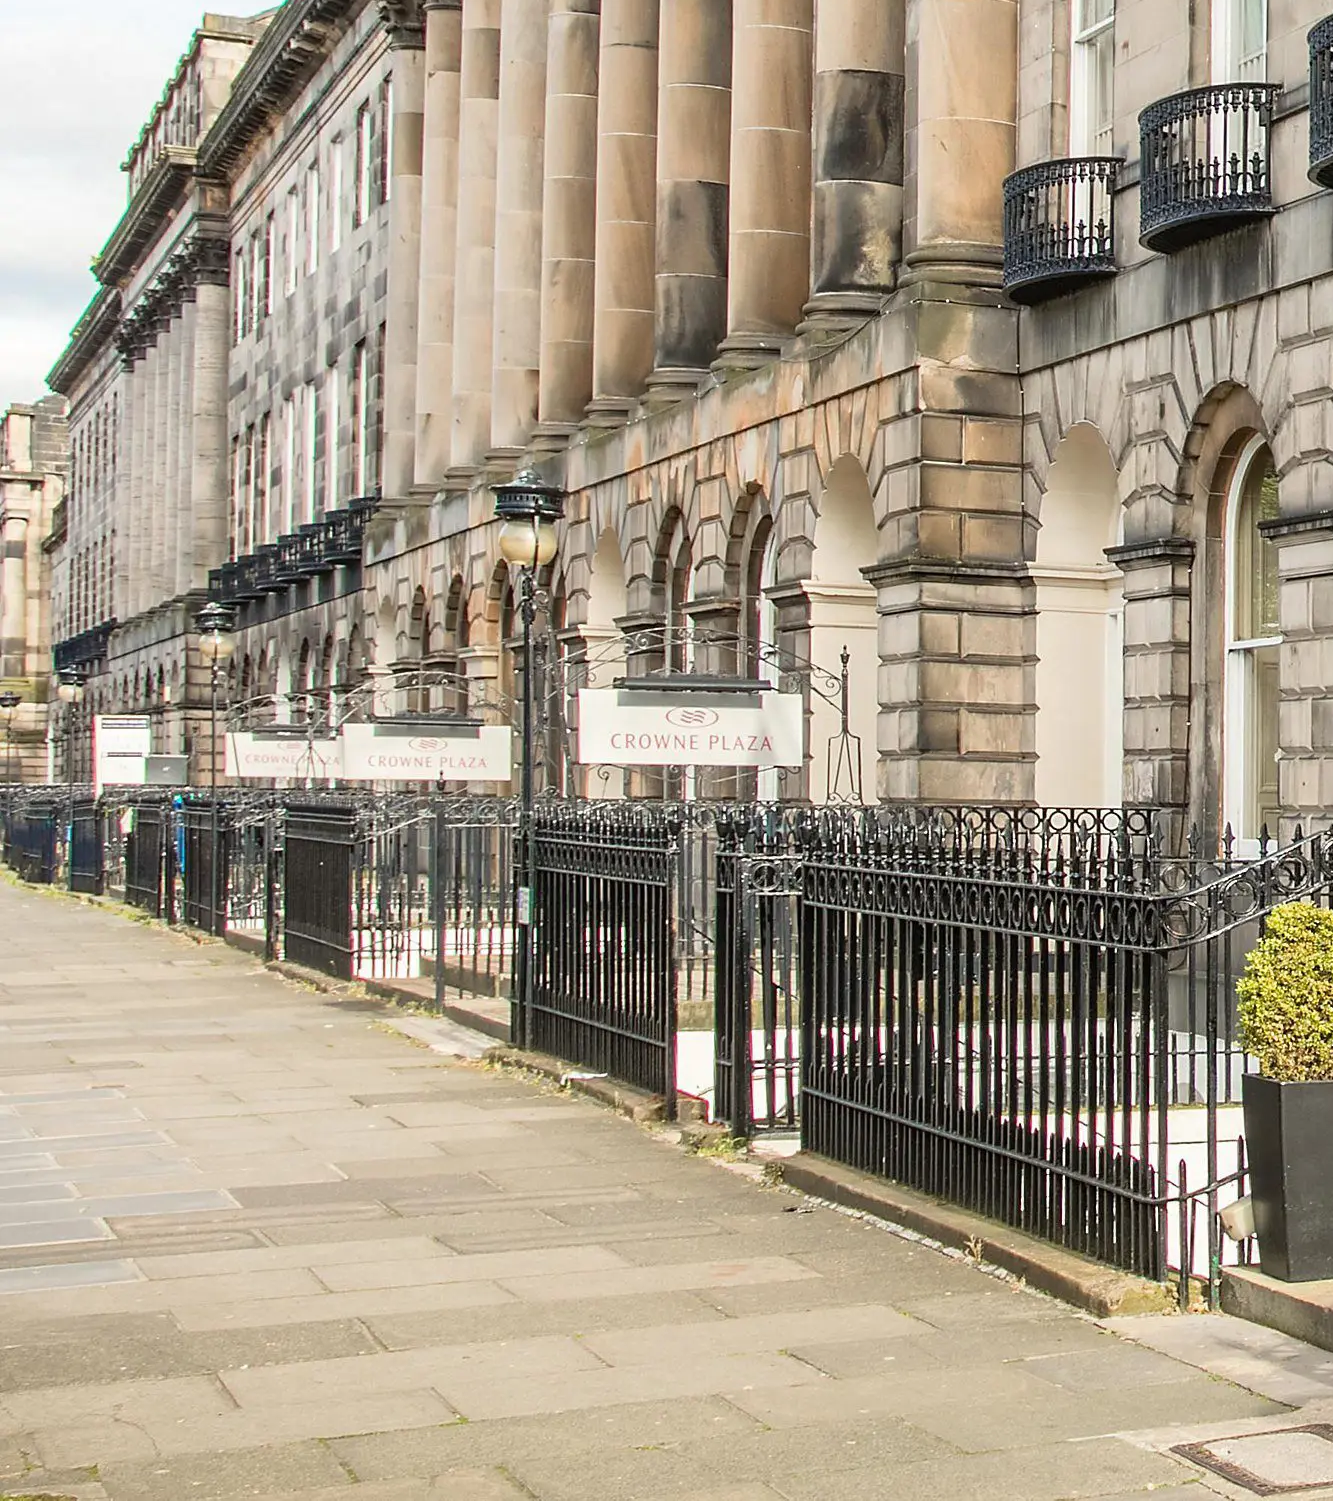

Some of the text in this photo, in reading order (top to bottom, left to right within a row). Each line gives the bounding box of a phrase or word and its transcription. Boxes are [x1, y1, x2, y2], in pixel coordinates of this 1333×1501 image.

[611, 733, 773, 751] CROWNE PLAZA
[367, 755, 488, 769] CROWNE PLAZA
